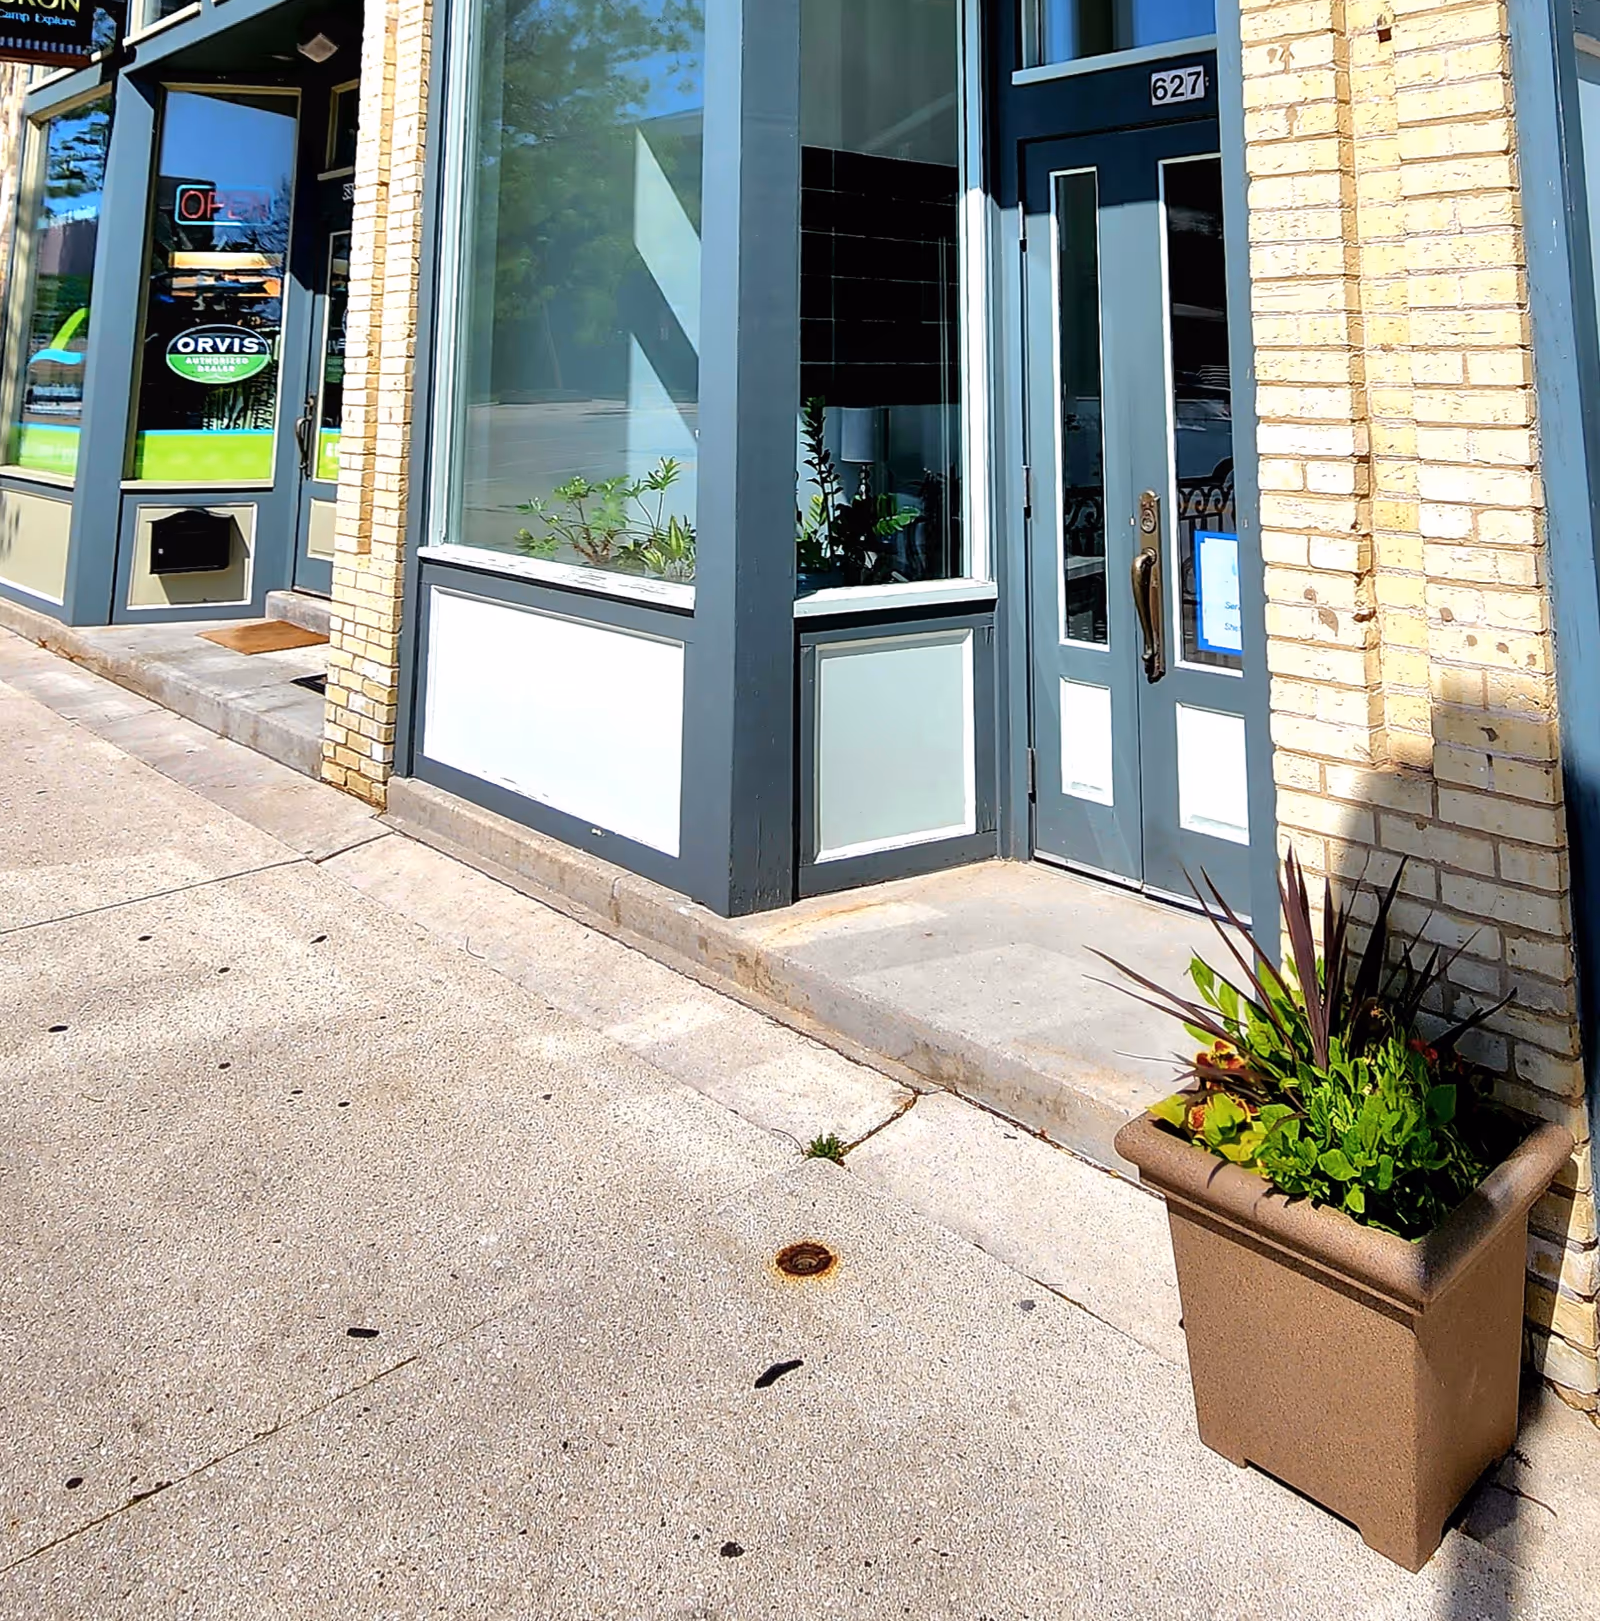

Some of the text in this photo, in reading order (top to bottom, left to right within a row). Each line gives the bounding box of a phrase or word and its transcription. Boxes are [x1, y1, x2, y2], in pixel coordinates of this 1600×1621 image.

[1152, 71, 1202, 101] 627
[181, 191, 269, 220] OPEN
[177, 337, 259, 353] ORVIS
[185, 357, 249, 365] AUTHORIZED
